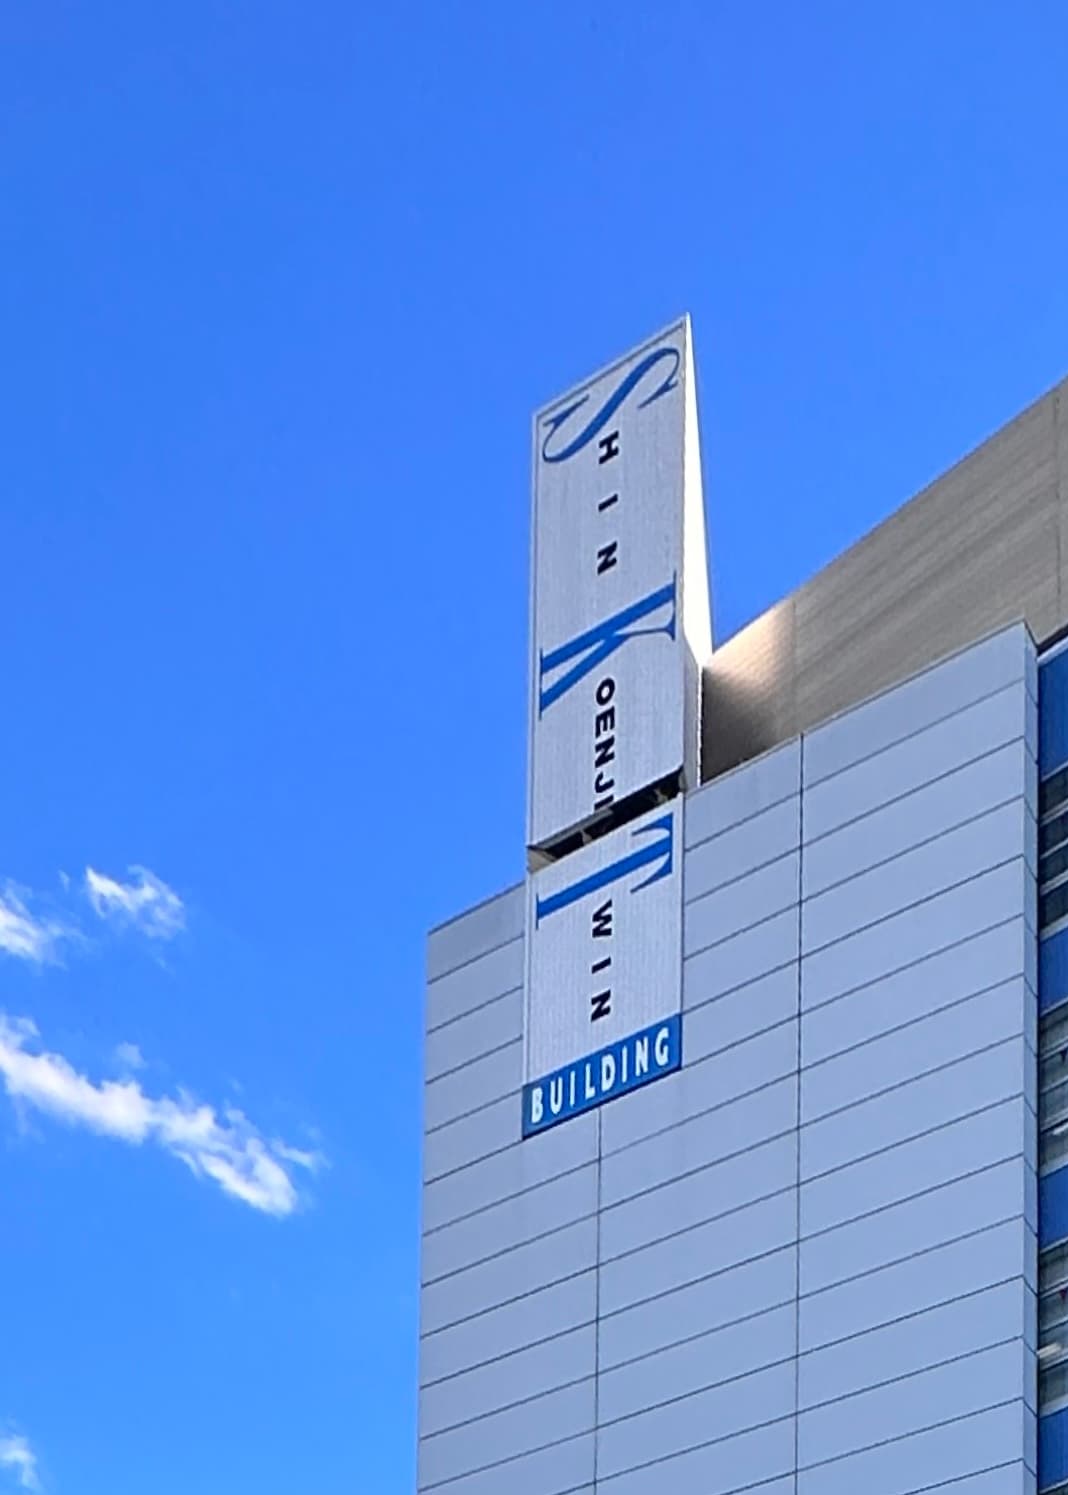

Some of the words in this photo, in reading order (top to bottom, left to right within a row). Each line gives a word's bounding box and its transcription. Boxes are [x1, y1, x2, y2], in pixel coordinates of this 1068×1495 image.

[541, 347, 681, 575] SHIN
[535, 811, 674, 1023] TWIN
[530, 1027, 671, 1125] BUILDING
